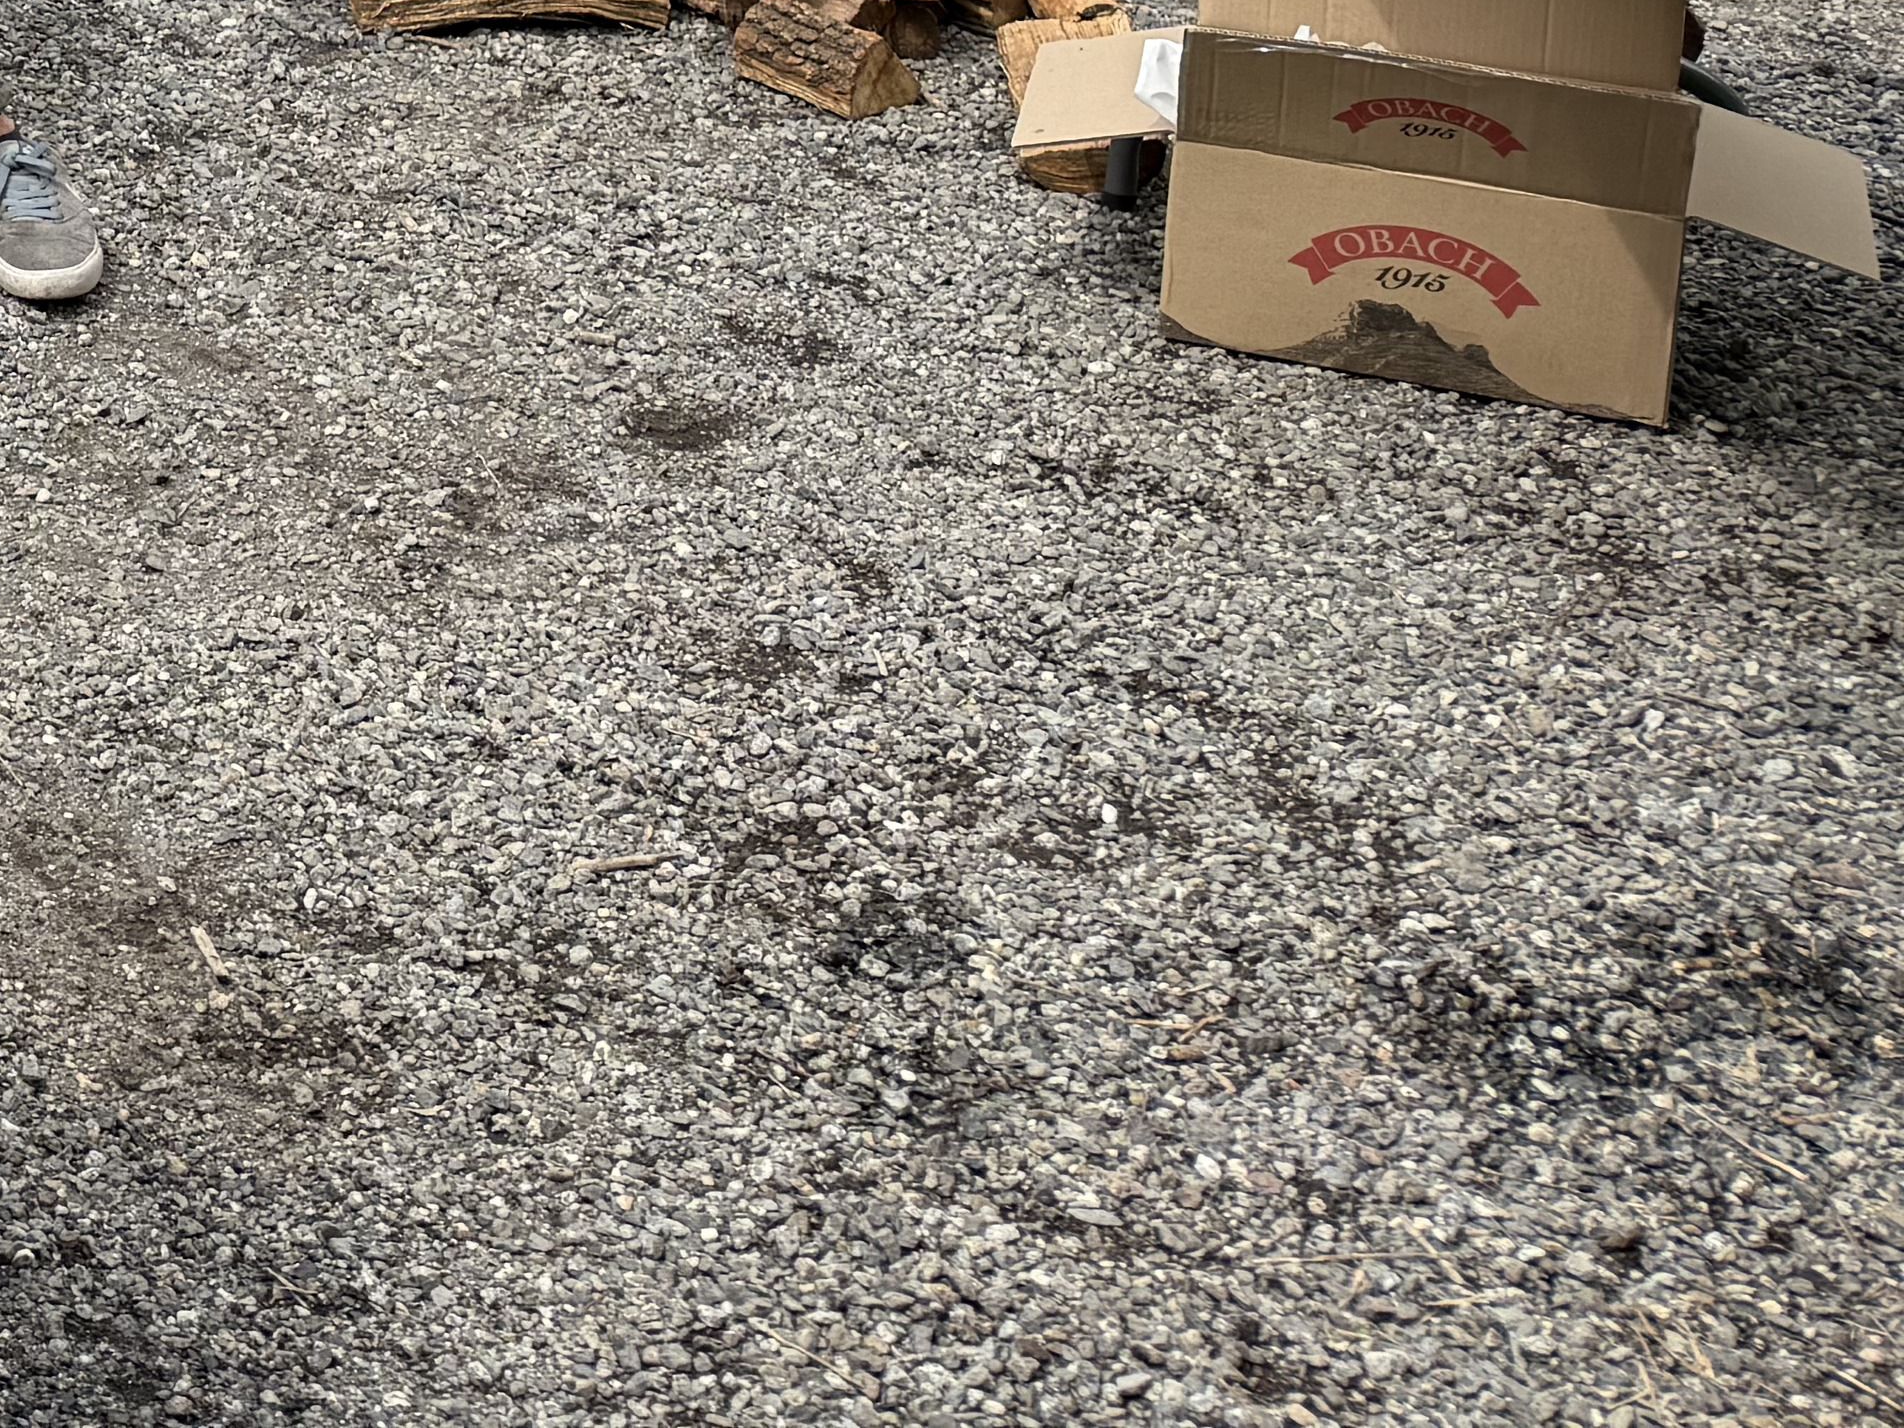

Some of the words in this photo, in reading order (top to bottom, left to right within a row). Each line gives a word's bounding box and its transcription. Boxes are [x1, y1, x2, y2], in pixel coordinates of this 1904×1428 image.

[1367, 97, 1491, 135] OBACH
[1398, 120, 1457, 142] 1915
[1332, 226, 1494, 283] OBACH
[1373, 265, 1451, 296] 1915
